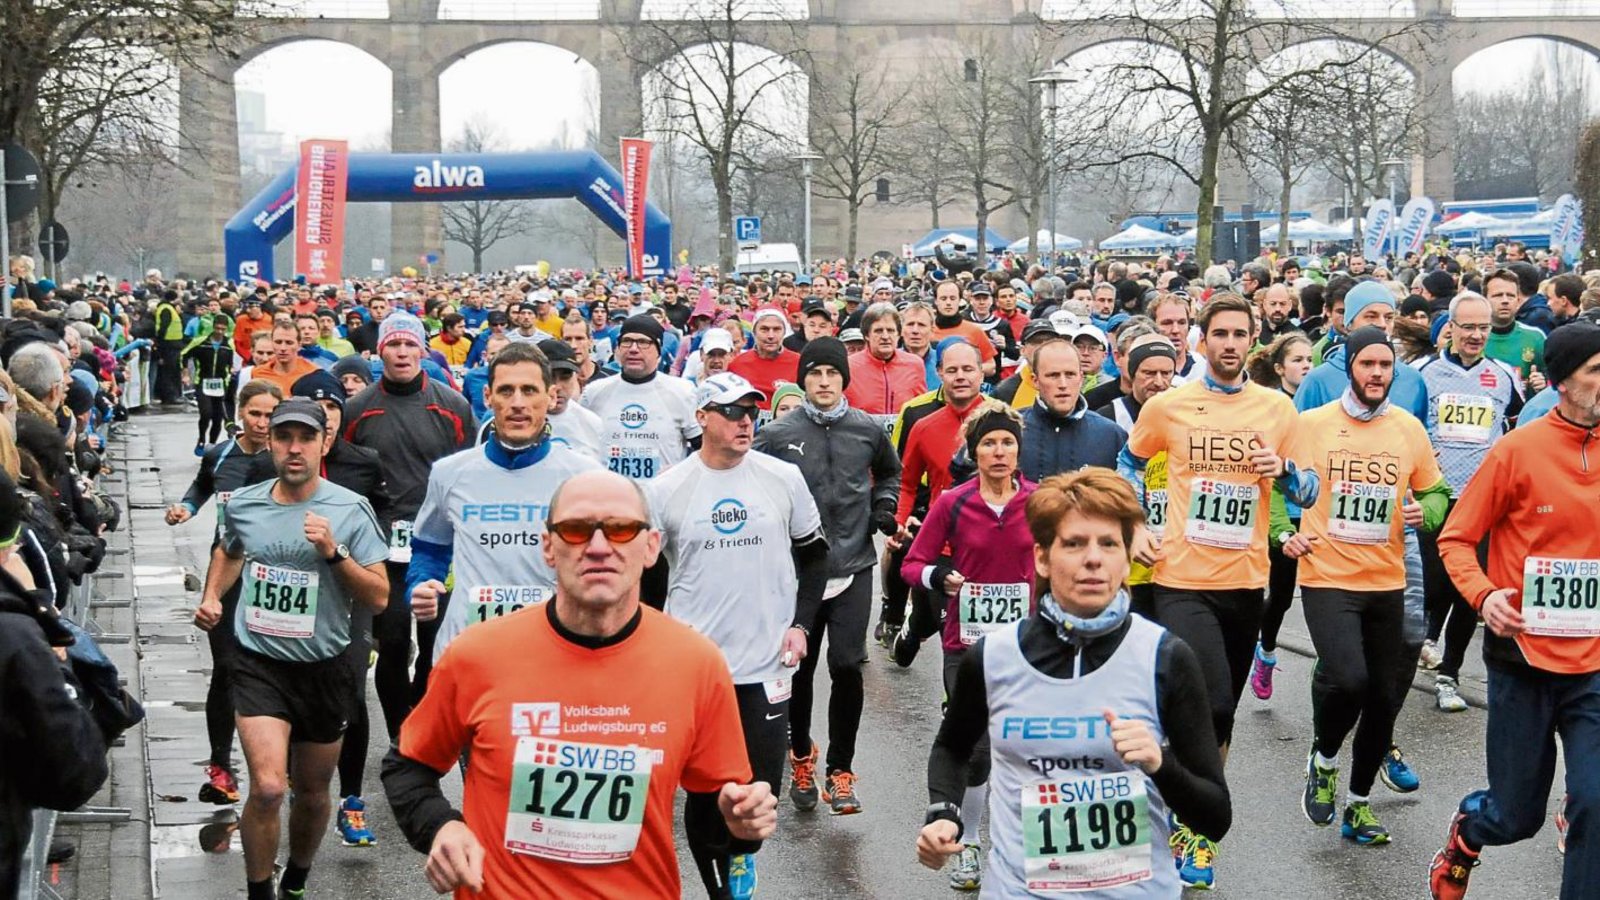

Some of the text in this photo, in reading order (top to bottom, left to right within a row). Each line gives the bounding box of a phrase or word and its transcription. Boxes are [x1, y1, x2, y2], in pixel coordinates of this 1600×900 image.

[413, 160, 485, 187] alwa
[741, 220, 754, 239] P
[1402, 207, 1427, 246] alwa
[620, 411, 648, 421] steko
[1444, 404, 1486, 425] 2517
[624, 432, 660, 440] Friends
[608, 457, 654, 478] 3638
[1189, 463, 1260, 474] REHA-ZENTRU
[1328, 458, 1398, 486] HESS
[712, 508, 748, 524] steko
[1195, 494, 1252, 526] 1195
[1336, 495, 1388, 523] 1194
[480, 530, 539, 549] sports
[704, 540, 716, 550] &
[252, 580, 309, 615] 1584
[1533, 576, 1599, 609] 1380
[967, 597, 1022, 624] 1325
[564, 704, 631, 717] Volksbank
[564, 720, 667, 735] Ludwigsburg eG
[1027, 755, 1105, 778] sports
[525, 767, 634, 822] 1276
[1038, 800, 1137, 855] 1198
